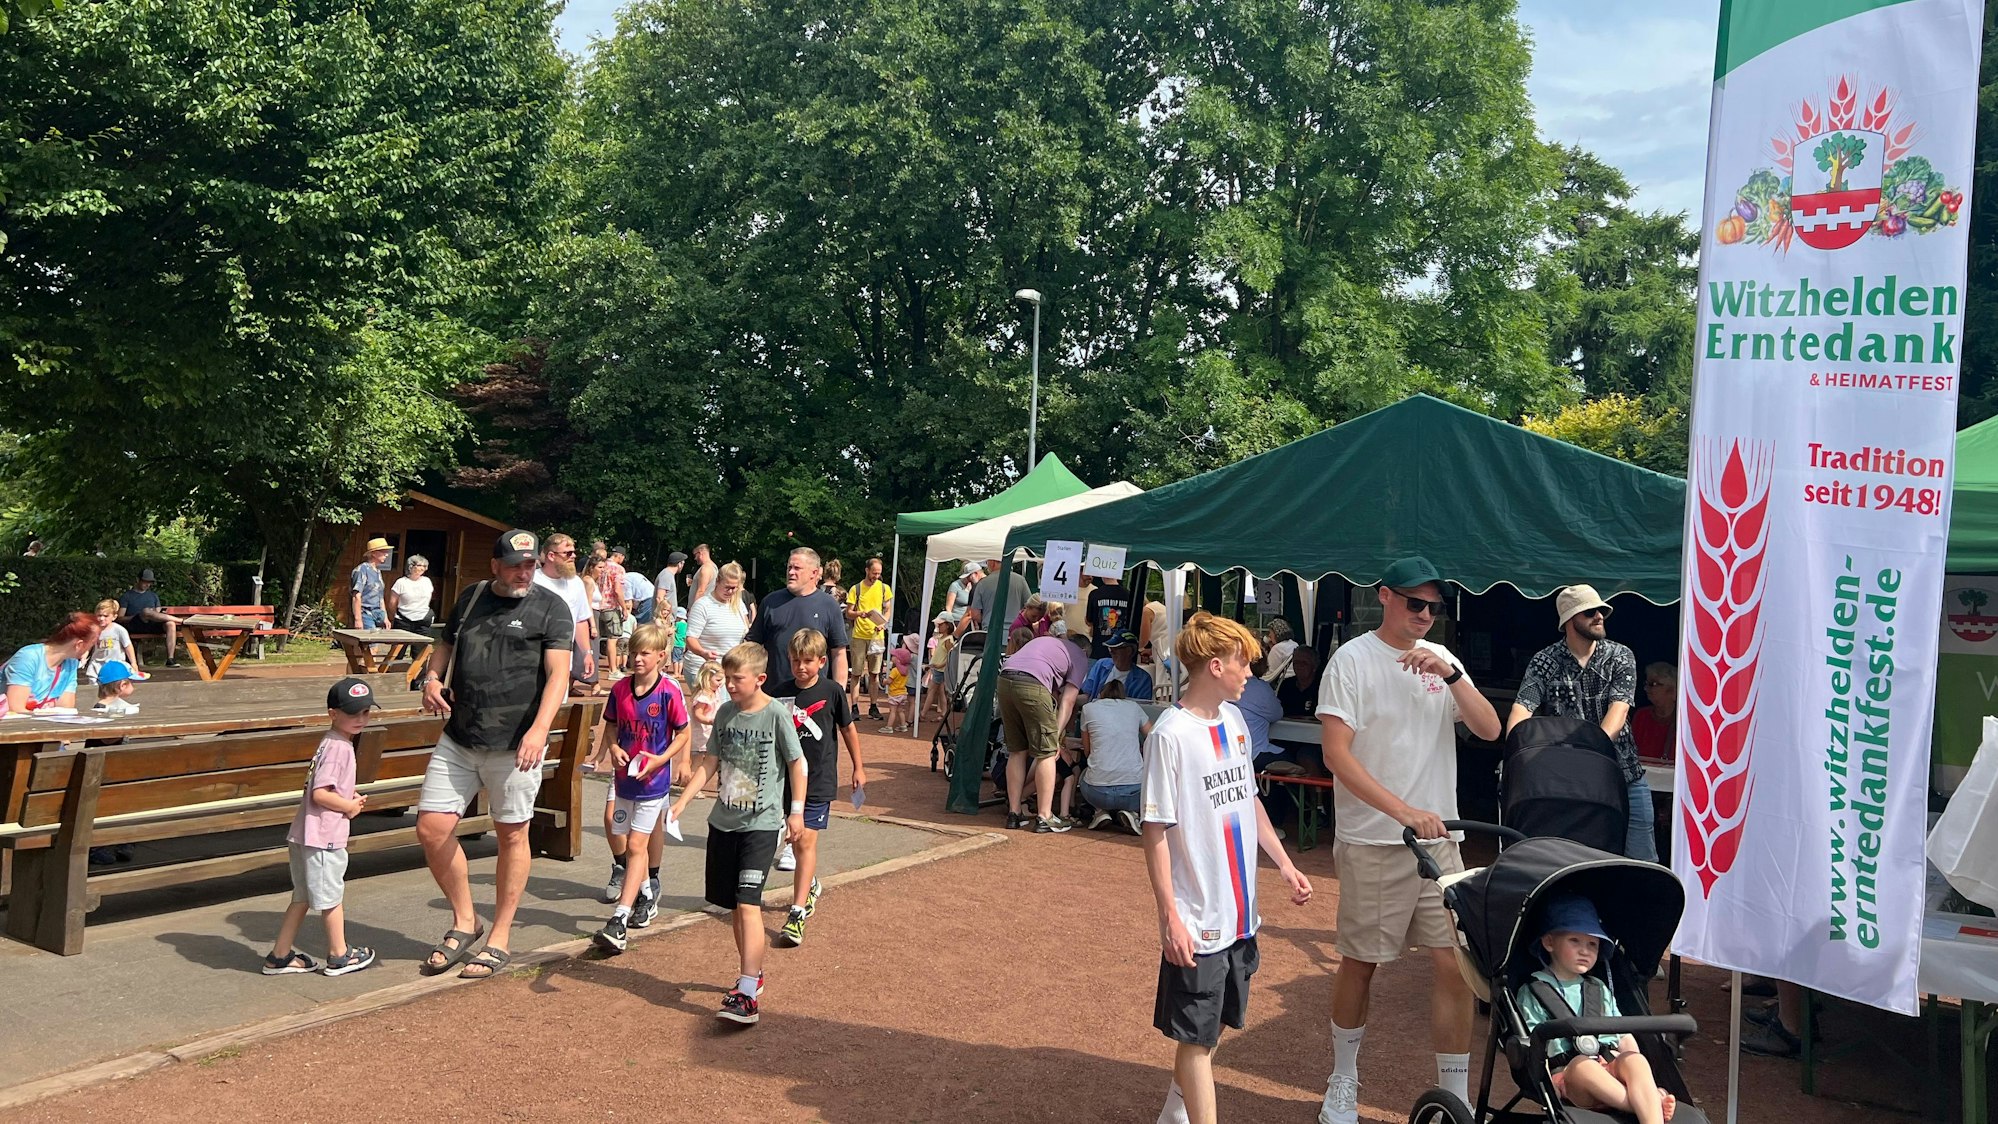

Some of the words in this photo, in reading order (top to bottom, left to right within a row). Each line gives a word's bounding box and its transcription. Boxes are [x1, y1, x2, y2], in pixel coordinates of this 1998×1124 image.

[1708, 275, 1957, 318] Witzhelden
[1705, 322, 1956, 363] Erntedank
[1809, 373, 1820, 386] &
[1825, 373, 1953, 391] HEIMATFEST
[1808, 443, 1945, 478] Tradition
[1053, 561, 1067, 586] 4
[1092, 556, 1118, 570] Quiz
[1264, 591, 1272, 605] 3
[1850, 567, 1901, 950] erntedankfest.de
[1209, 783, 1248, 809] TRUCKS
